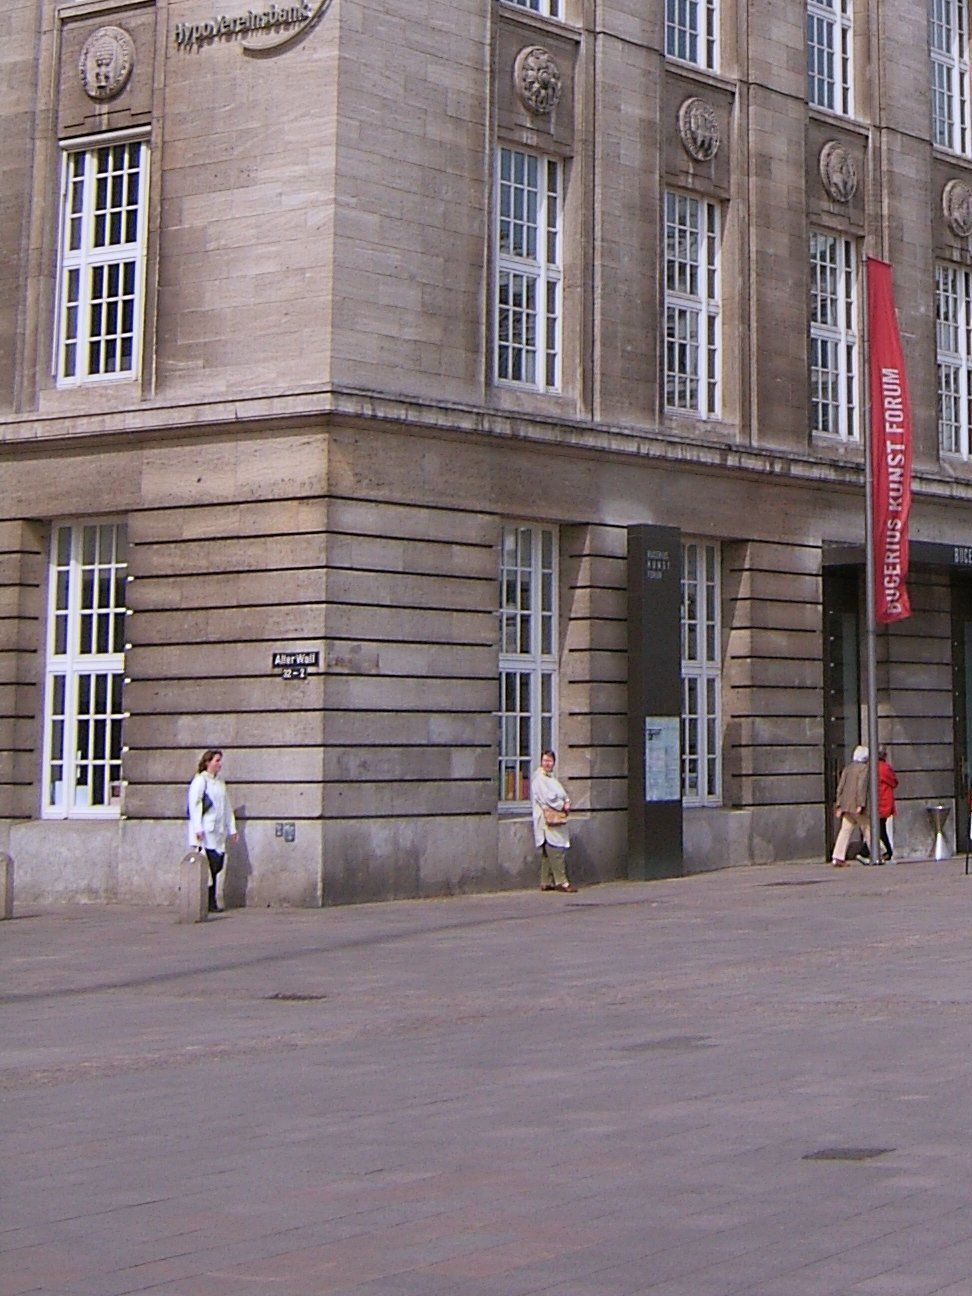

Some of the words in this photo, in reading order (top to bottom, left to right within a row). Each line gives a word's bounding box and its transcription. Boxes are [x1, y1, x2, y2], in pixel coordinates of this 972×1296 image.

[881, 367, 904, 434] FORUM
[886, 440, 905, 511] KUNST
[275, 654, 295, 665] Alter
[296, 653, 316, 664] Wall
